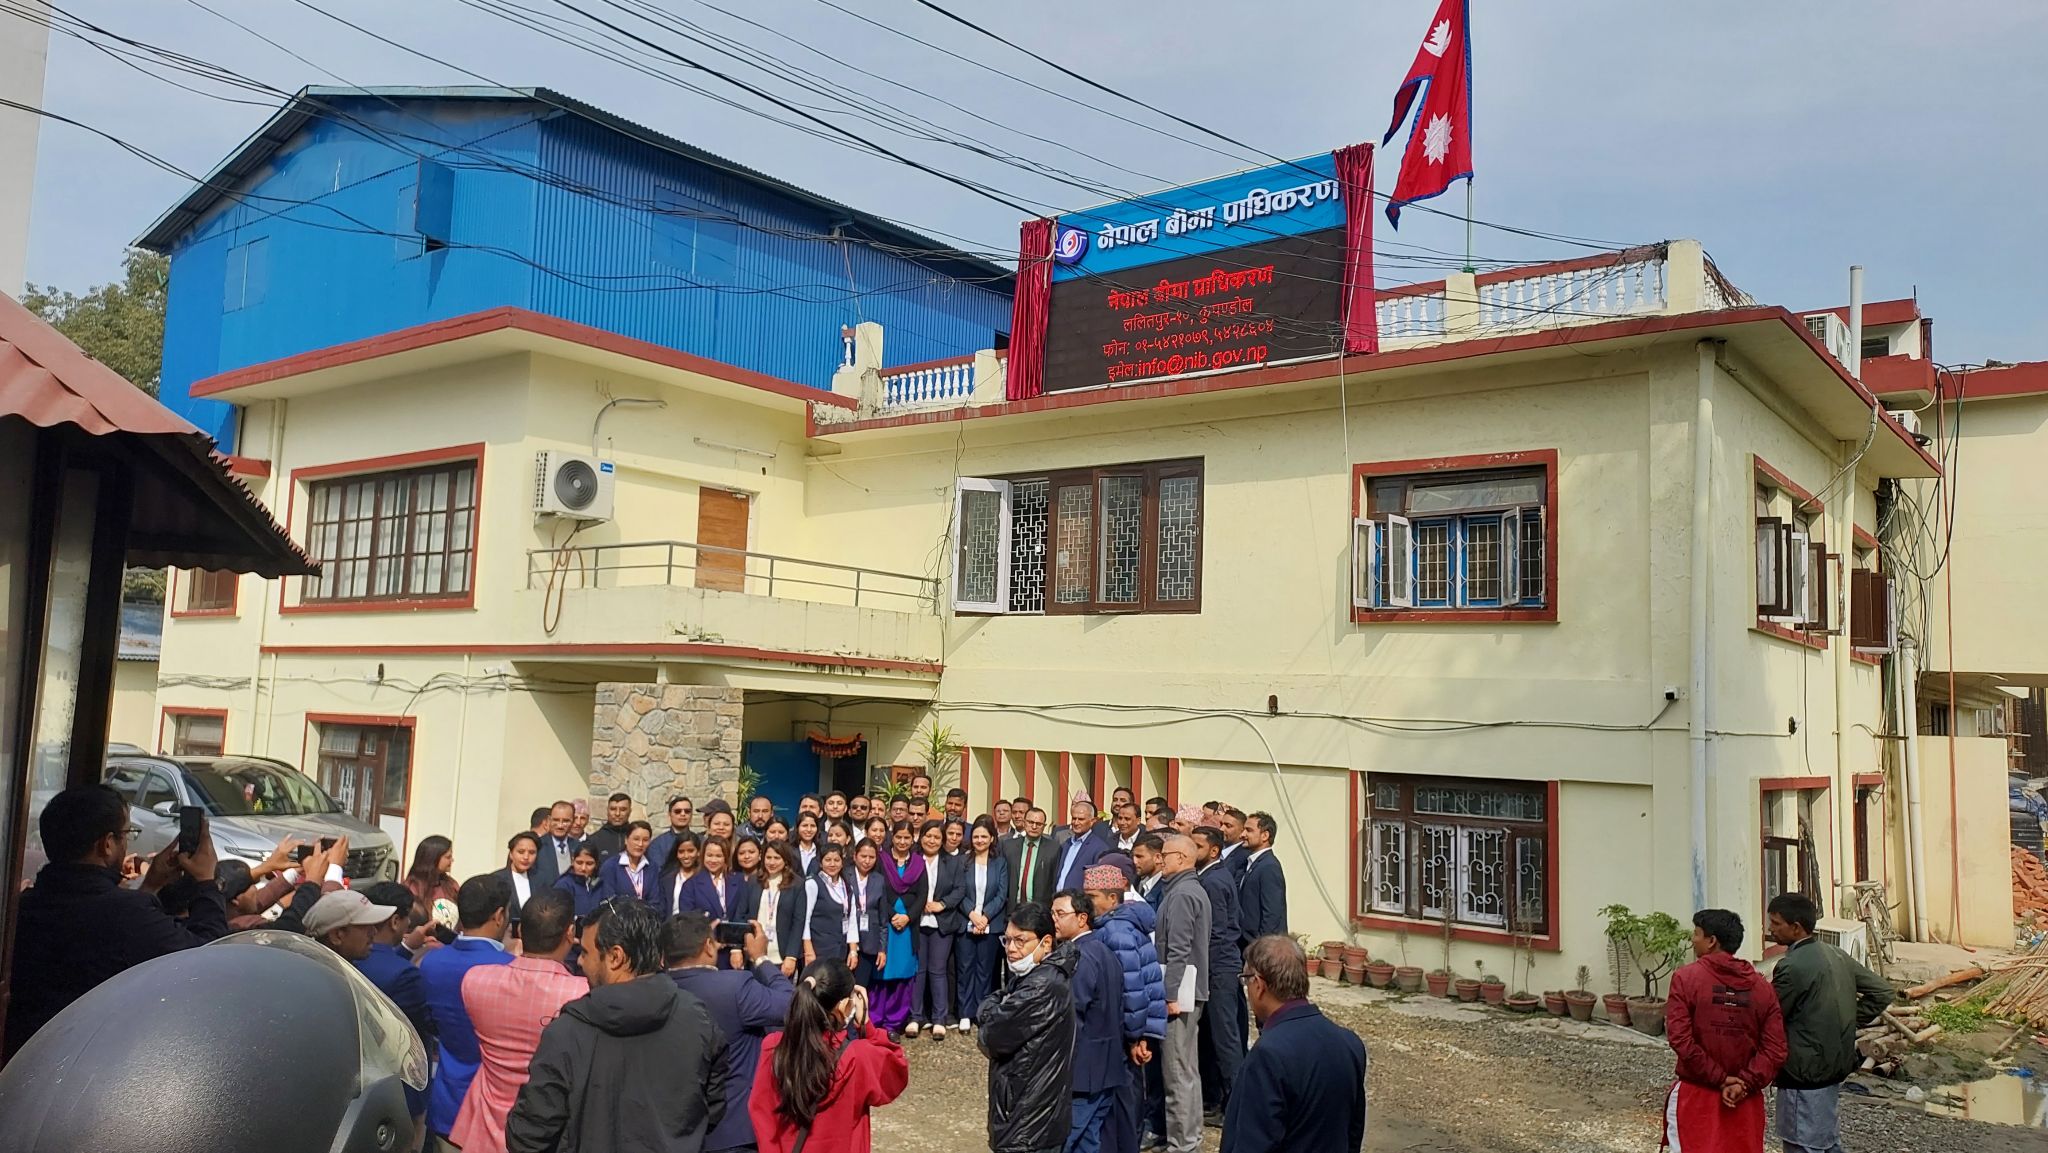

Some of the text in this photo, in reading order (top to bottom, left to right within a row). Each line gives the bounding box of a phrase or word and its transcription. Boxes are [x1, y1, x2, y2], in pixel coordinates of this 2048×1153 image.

[1097, 178, 1340, 250] नेपाल बीमा प्राधिकरण
[1107, 288, 1149, 311] नेपाल
[1193, 265, 1274, 296] प्राधिकरण
